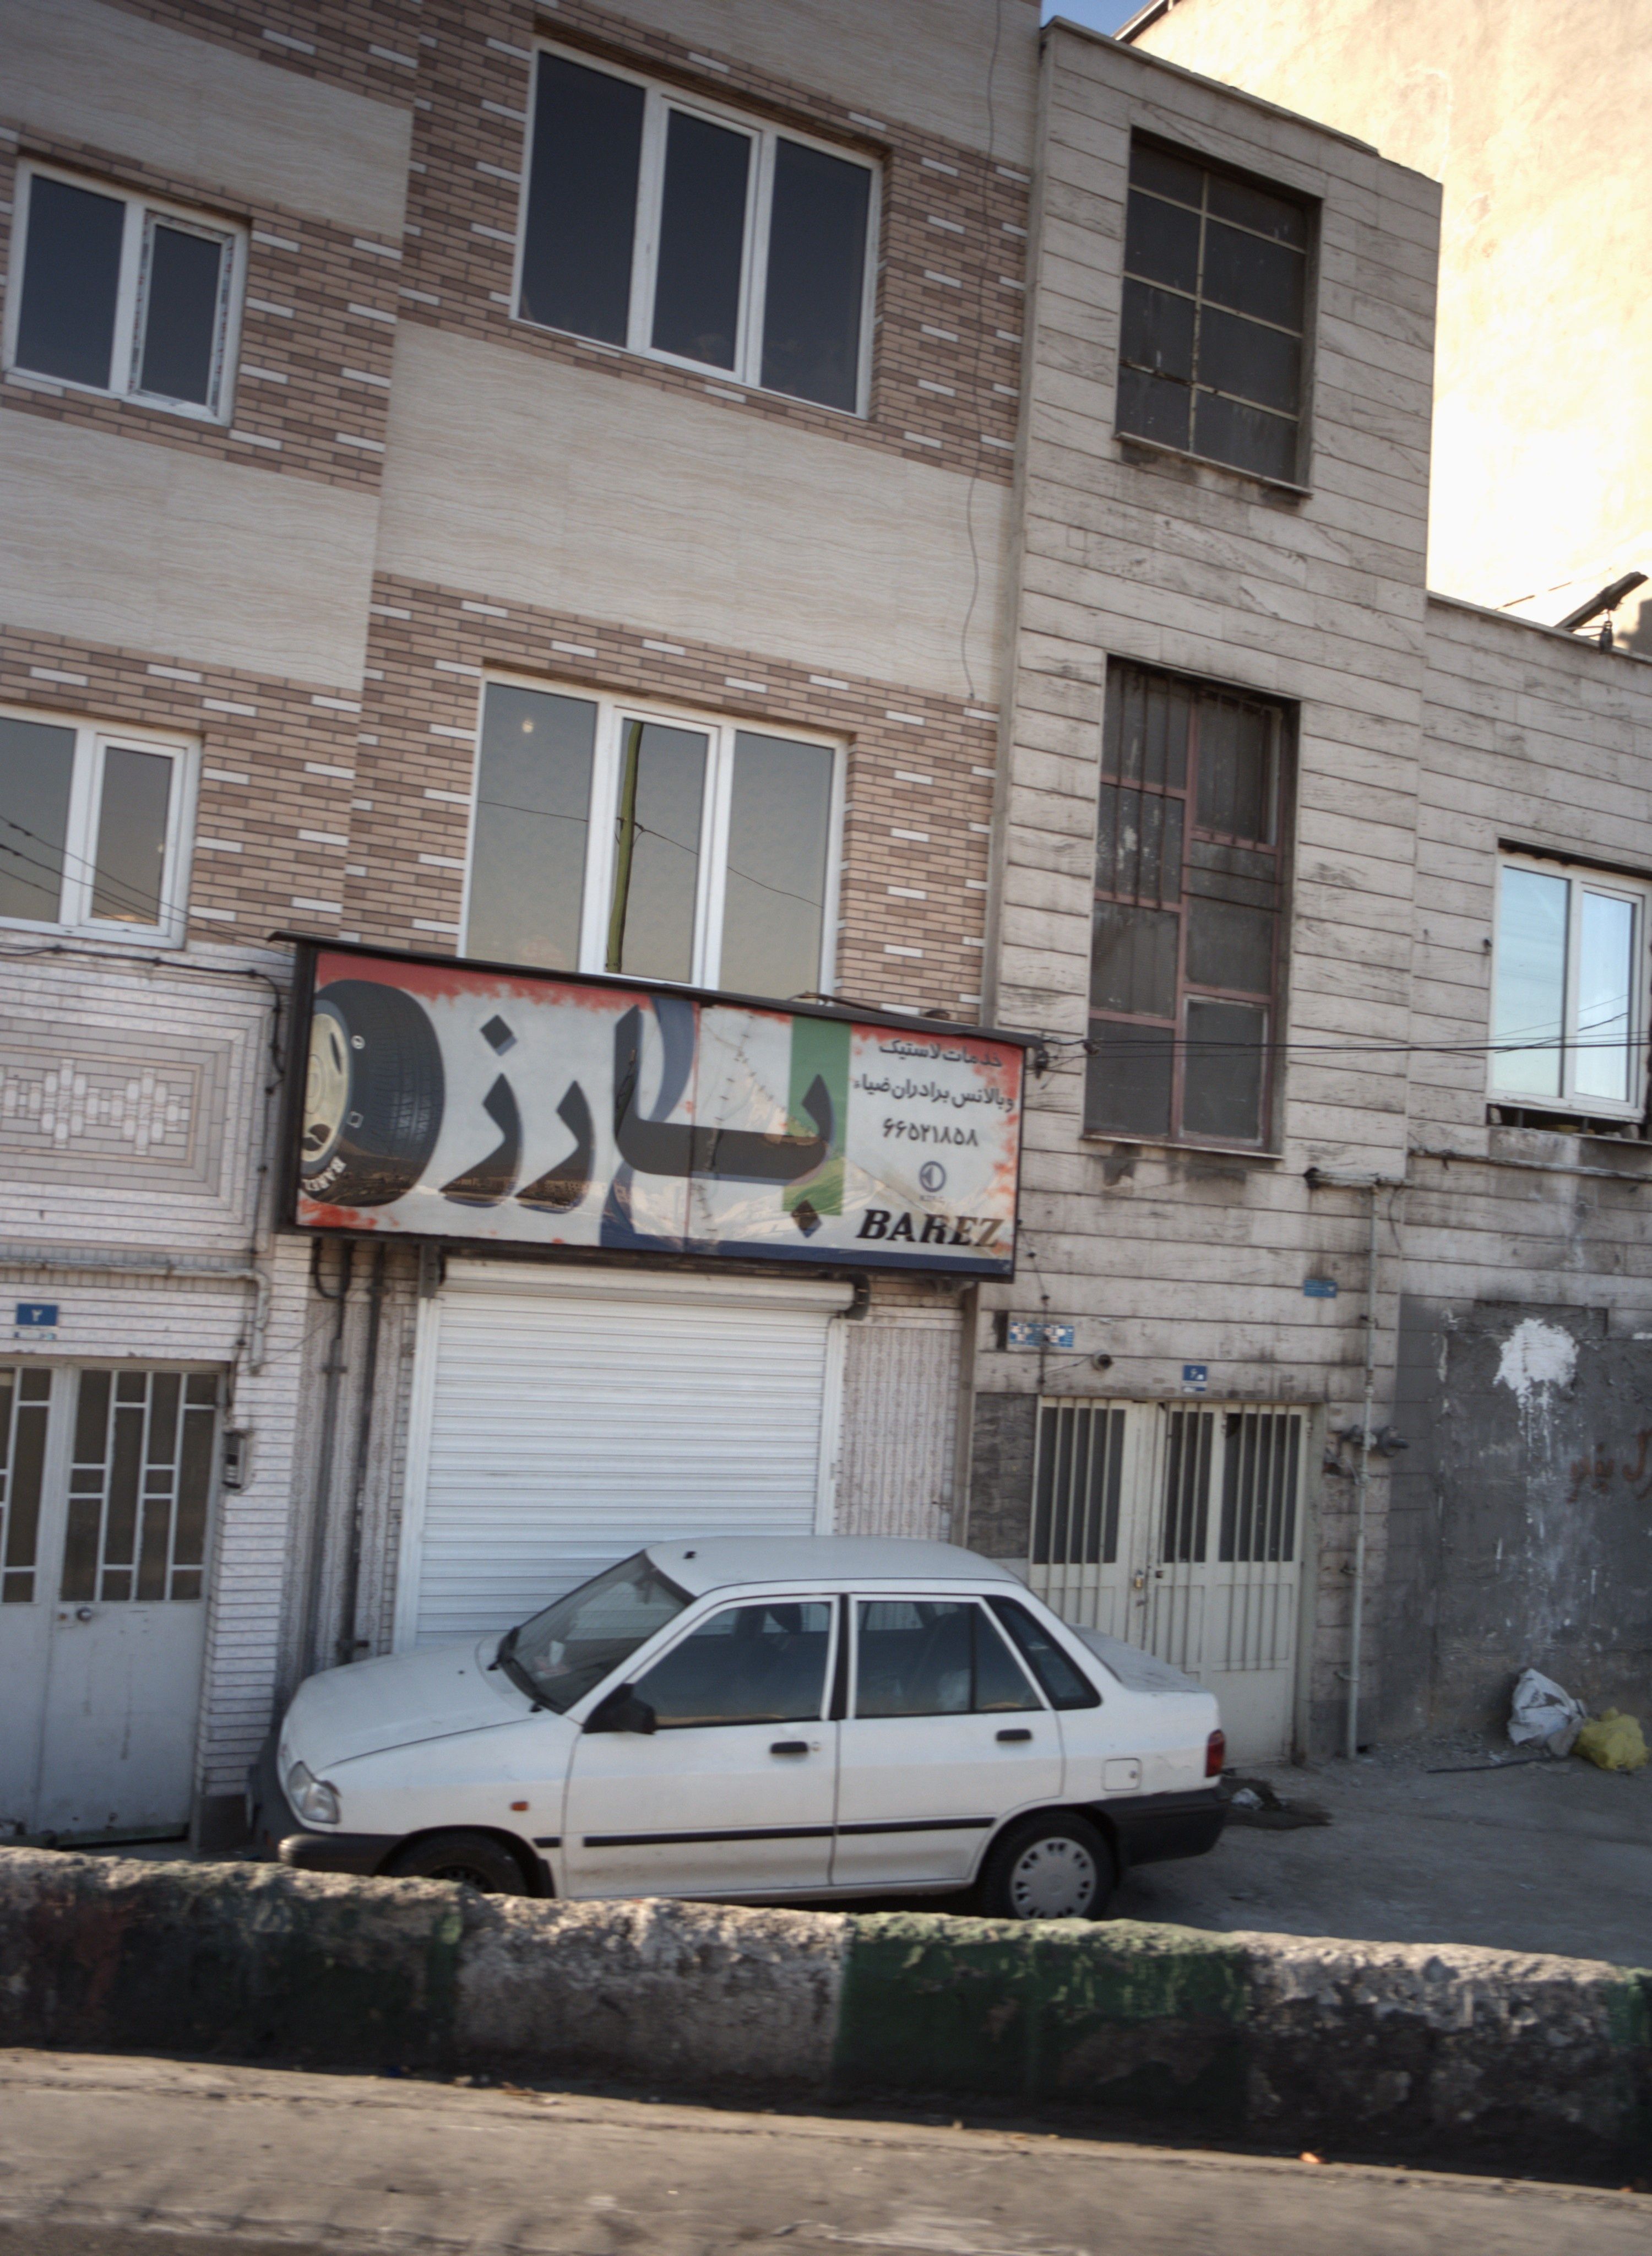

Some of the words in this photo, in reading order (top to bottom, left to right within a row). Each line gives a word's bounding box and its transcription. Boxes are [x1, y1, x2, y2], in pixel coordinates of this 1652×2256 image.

[878, 1039, 941, 1059] لاستیک
[942, 1046, 1002, 1067] خدمات
[891, 1078, 950, 1102] برادران
[439, 1004, 836, 1238] بارز
[882, 1118, 979, 1147] ۶۶۵۲۱۸۵۸
[855, 1208, 1004, 1248] BAREZ
